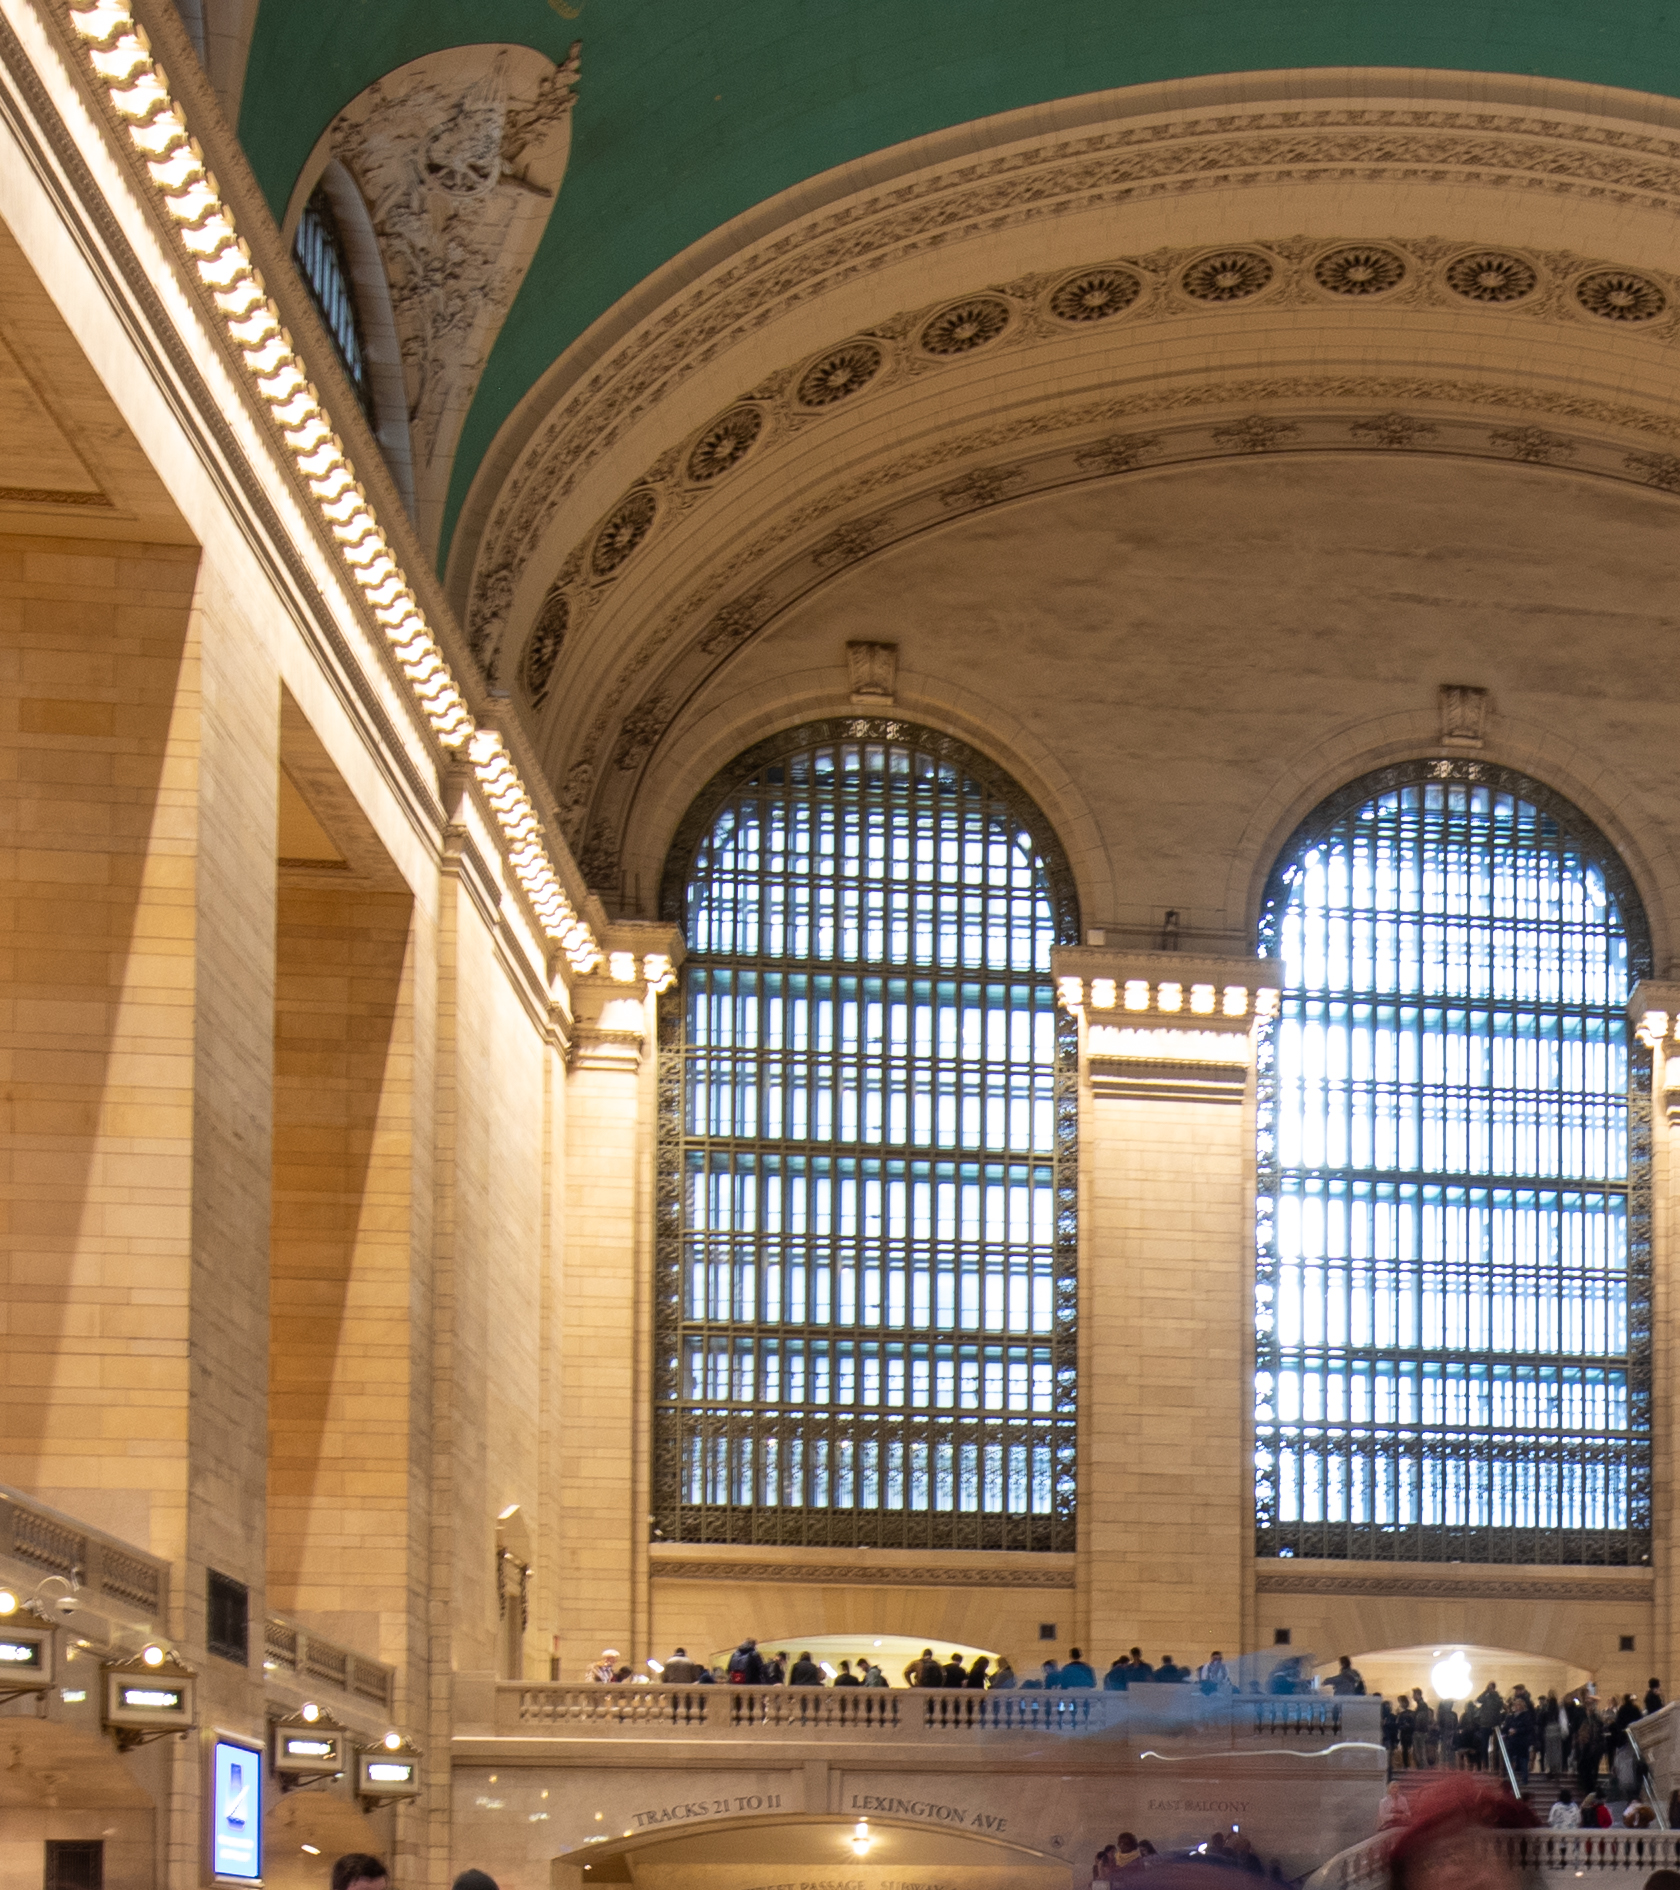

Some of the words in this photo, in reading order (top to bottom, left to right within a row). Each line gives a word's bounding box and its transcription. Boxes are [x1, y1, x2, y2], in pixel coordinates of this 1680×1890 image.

[633, 1801, 710, 1827] TRACKS
[713, 1800, 731, 1814] 21
[733, 1796, 763, 1812] TO
[852, 1795, 970, 1824] LEXINGTON
[971, 1814, 1008, 1833] AVE
[1148, 1799, 1181, 1811] EAST
[1184, 1801, 1250, 1812] BALCONY
